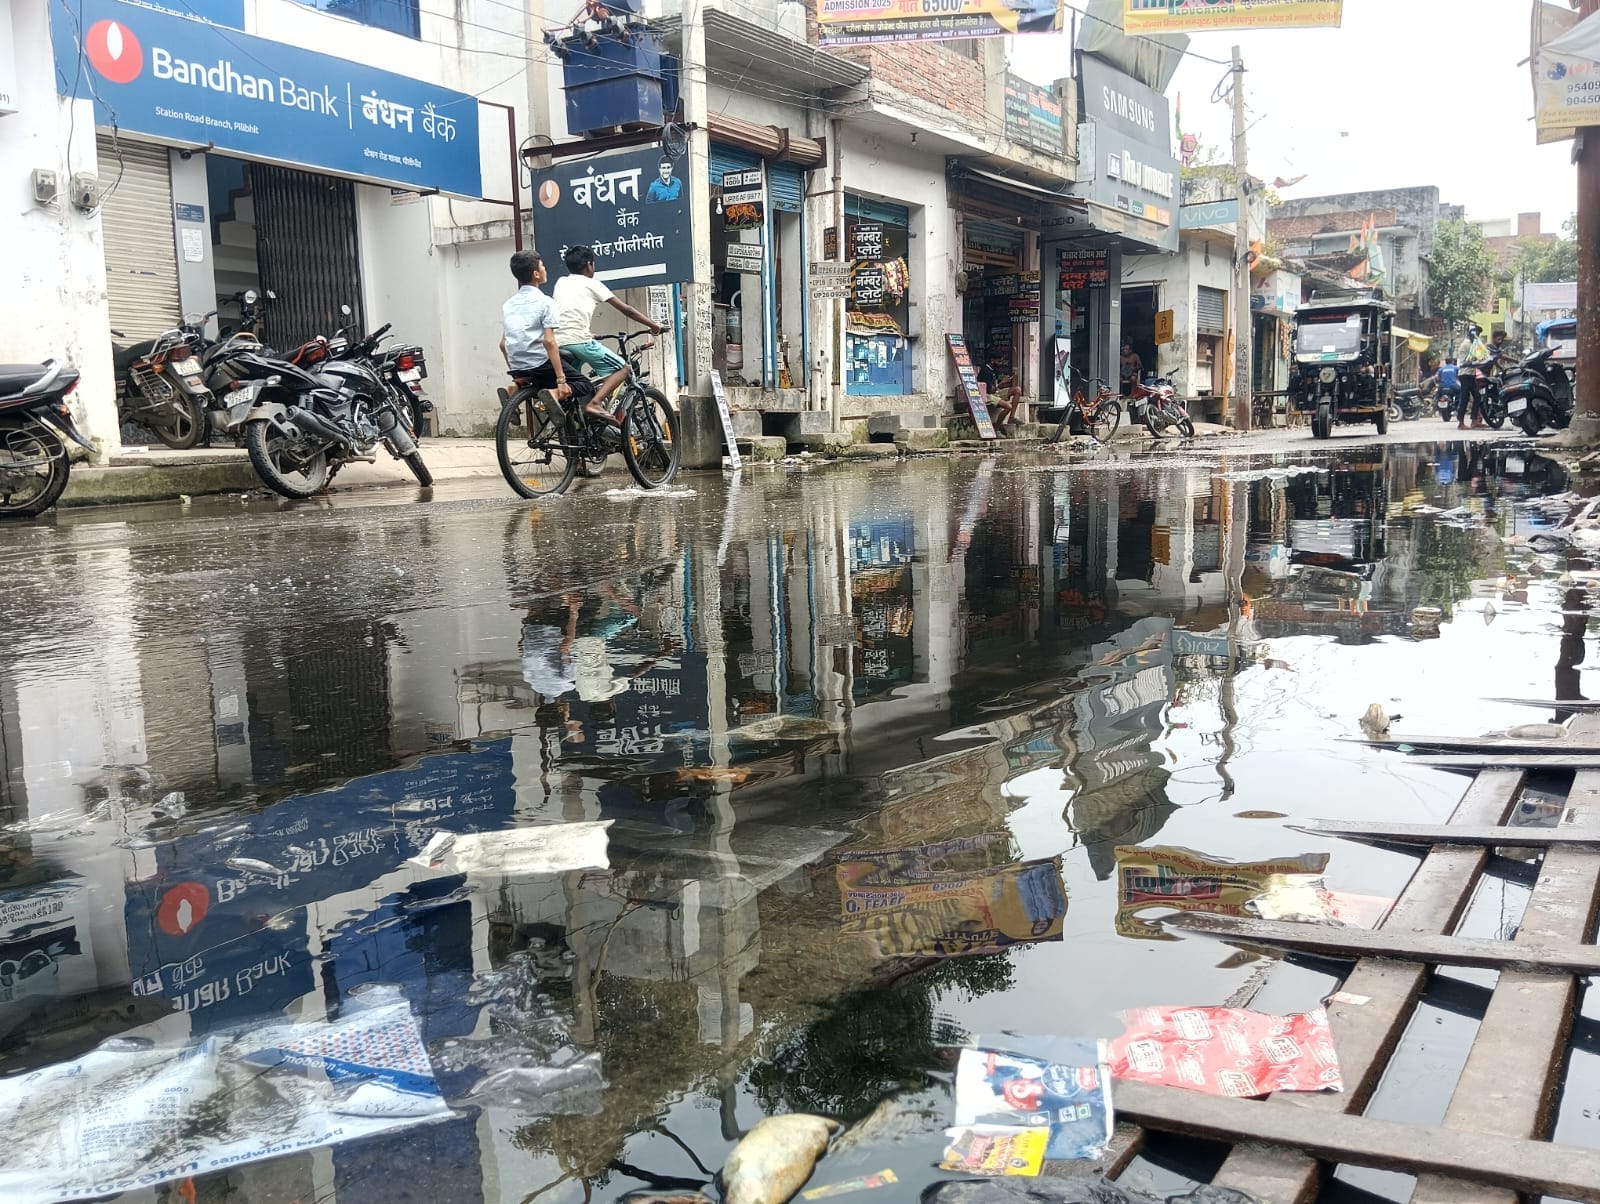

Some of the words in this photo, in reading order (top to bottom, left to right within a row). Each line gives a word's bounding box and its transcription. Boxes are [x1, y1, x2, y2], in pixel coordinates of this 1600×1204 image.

[824, 0, 869, 11] ADMISSION
[152, 47, 275, 102] Bandhan
[279, 77, 339, 117] Bank
[155, 106, 184, 120] Station
[184, 112, 205, 124] Road
[205, 116, 233, 131] Branch,
[233, 122, 259, 135] Pilibhit
[360, 89, 414, 133] बंधन
[421, 101, 457, 142] बैंक
[1103, 85, 1155, 132] SAMSUNG
[570, 165, 642, 208] बंधन
[616, 207, 640, 228] बैंक
[856, 232, 882, 243] नम्बर
[856, 276, 882, 287] नम्बर
[210, 1142, 293, 1167] sandwich
[297, 1127, 344, 1148] bread
